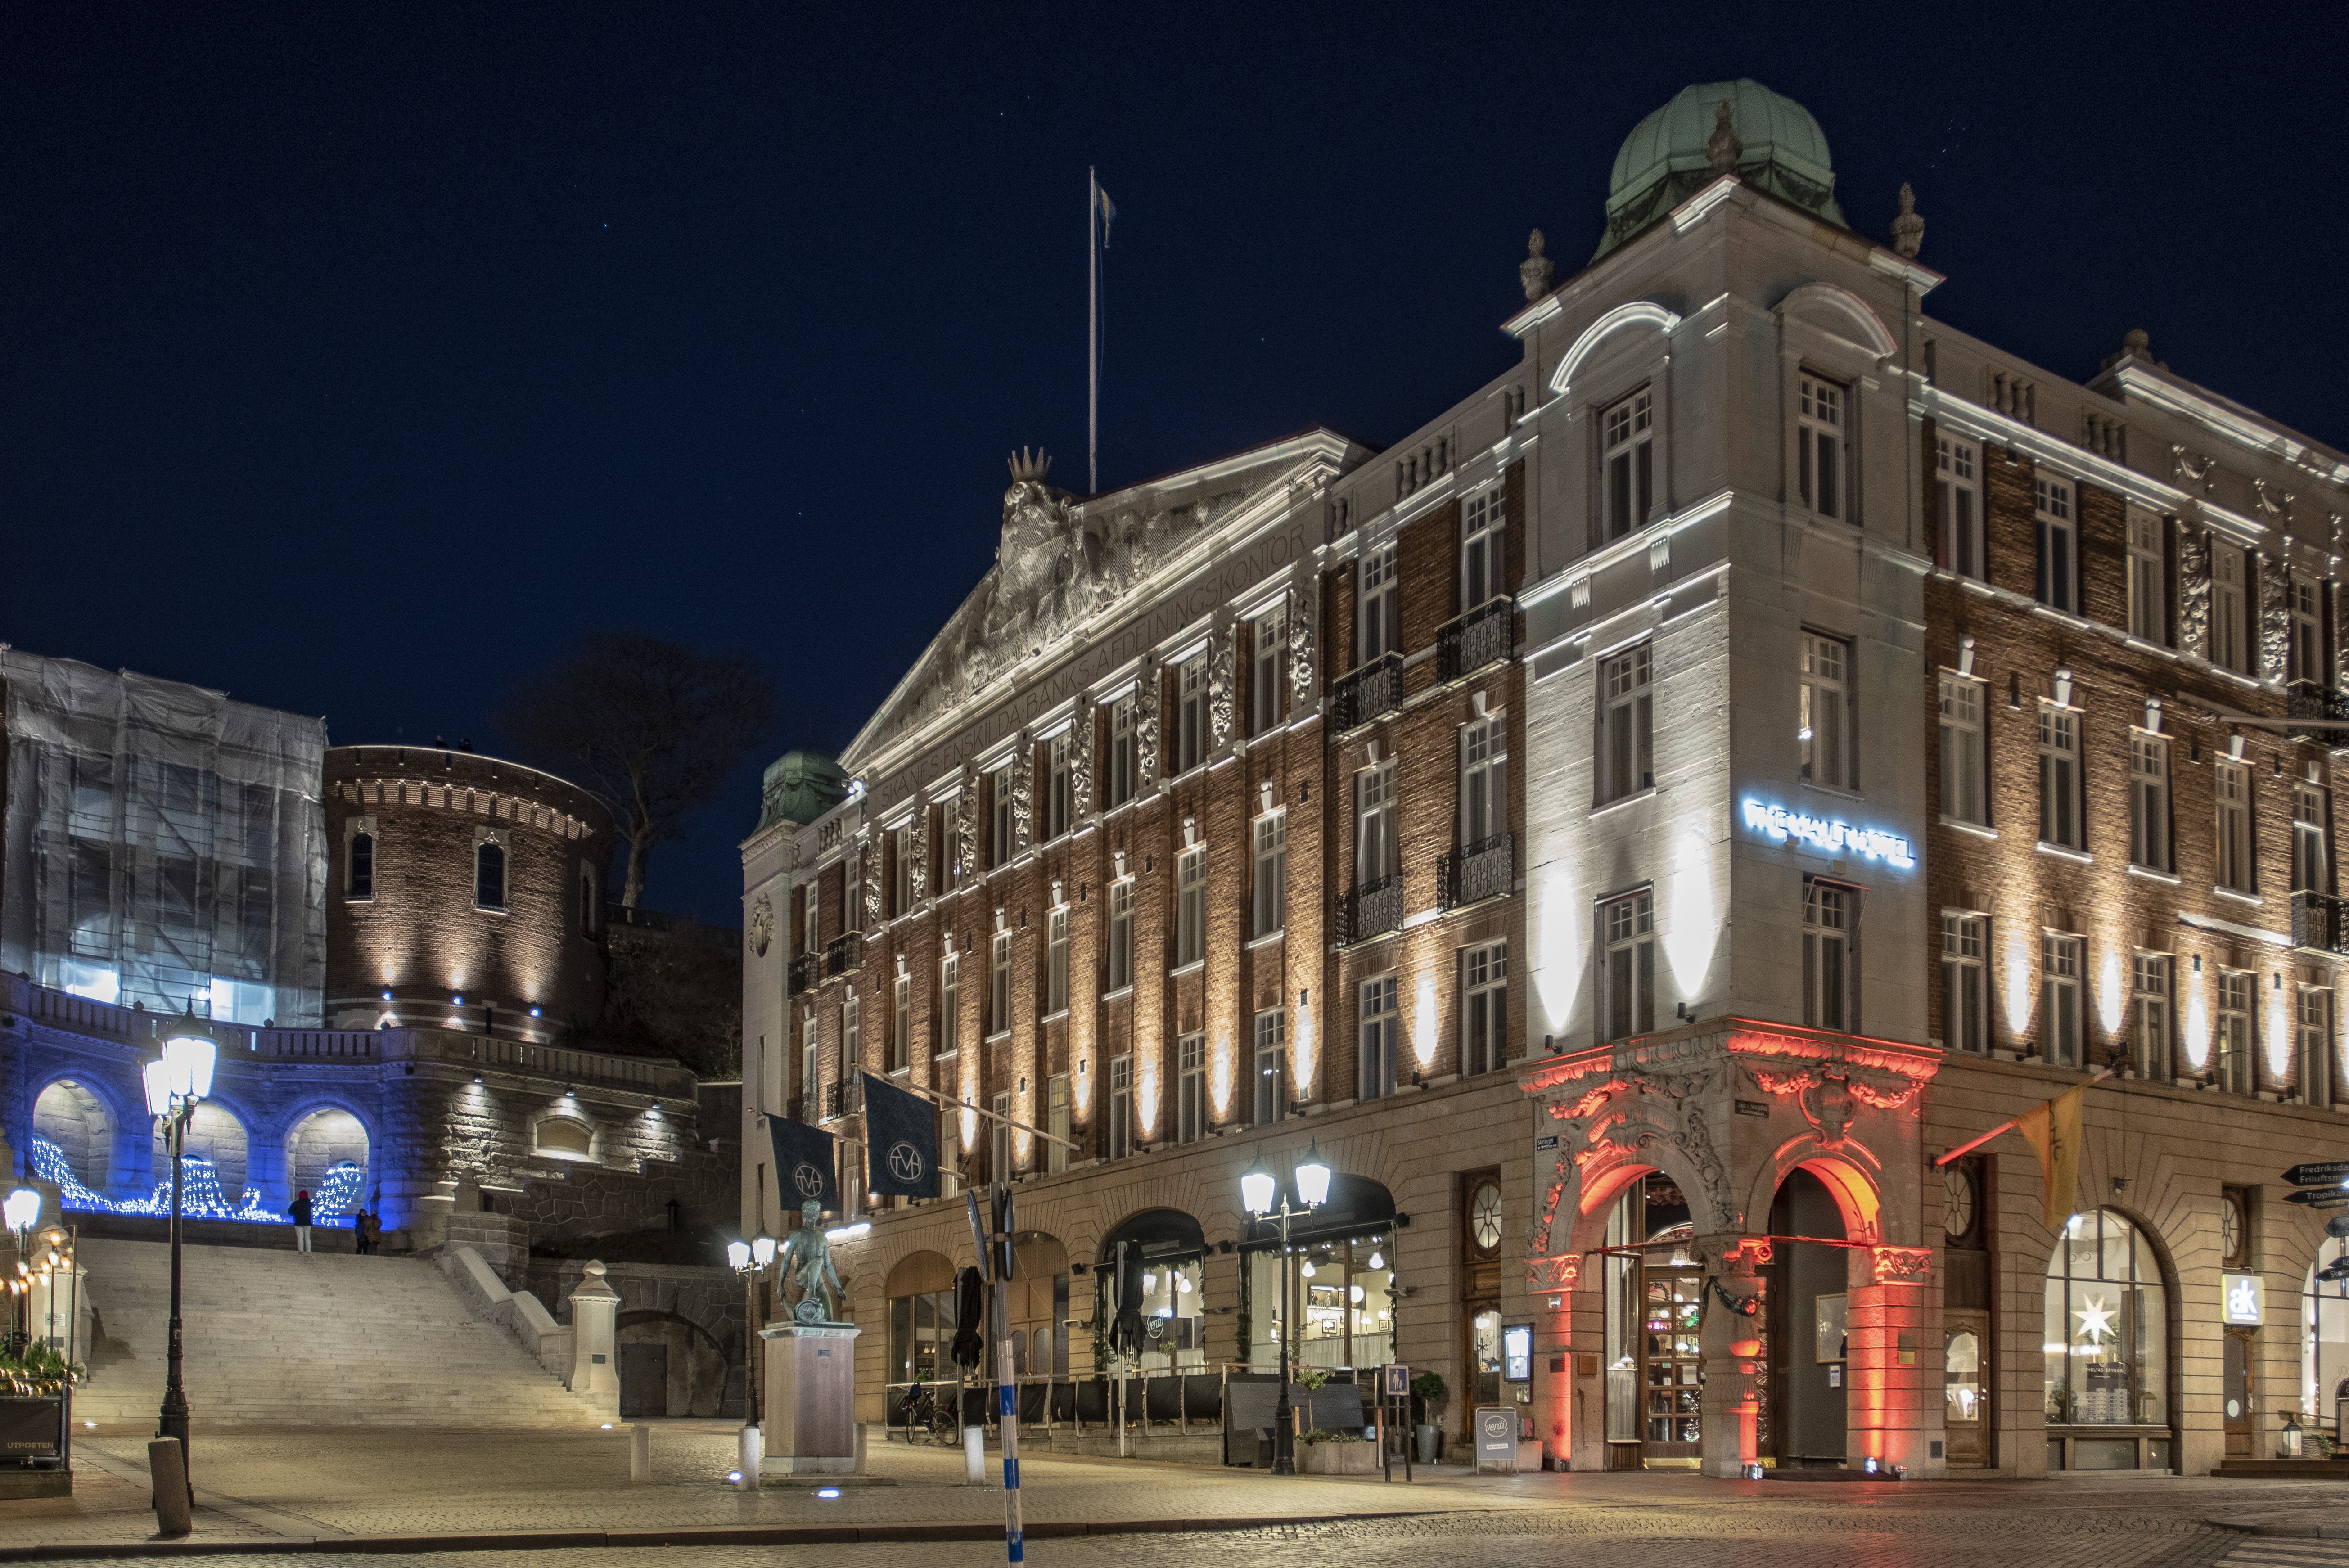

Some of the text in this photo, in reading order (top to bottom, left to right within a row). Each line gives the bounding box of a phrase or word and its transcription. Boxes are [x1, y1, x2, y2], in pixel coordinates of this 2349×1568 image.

[944, 704, 1021, 770] ENSKILDA
[1026, 660, 1090, 719] BANKS
[1096, 523, 1306, 676] AFDELNINGSKONTOR
[1485, 1420, 1506, 1432] venti
